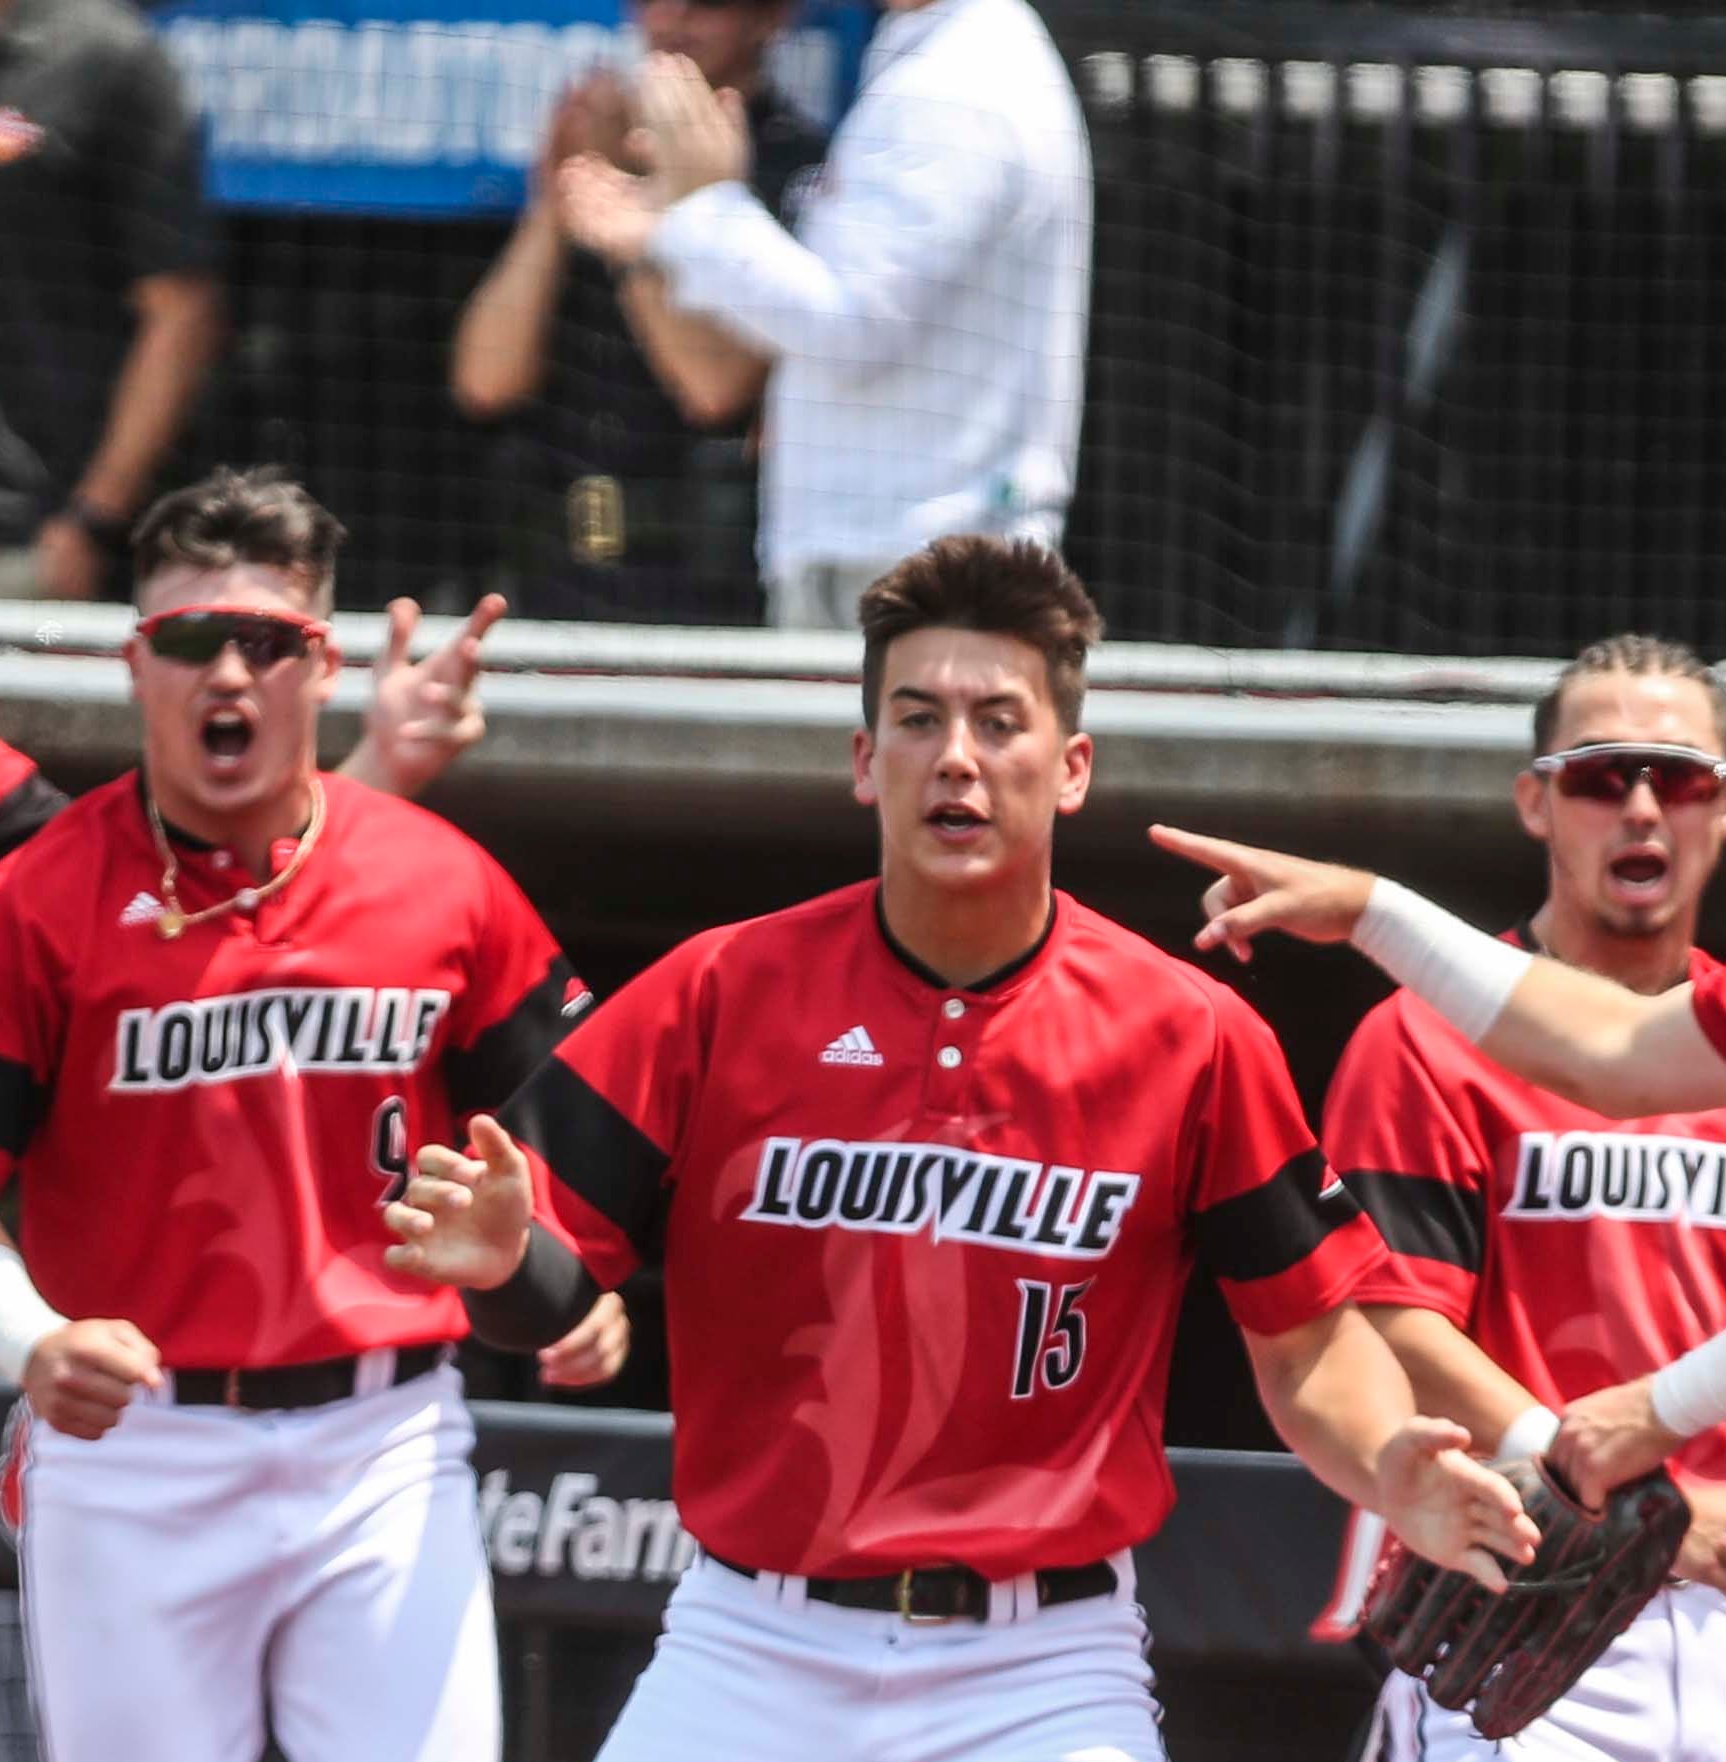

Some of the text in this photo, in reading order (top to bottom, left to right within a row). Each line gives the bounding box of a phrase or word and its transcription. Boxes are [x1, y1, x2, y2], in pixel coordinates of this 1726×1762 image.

[107, 986, 451, 1092] LOUISVILLE
[818, 1049, 884, 1068] adidas
[370, 1095, 421, 1209] 9
[739, 1136, 1141, 1261] LOUISVILLE
[1009, 1275, 1097, 1399] 15
